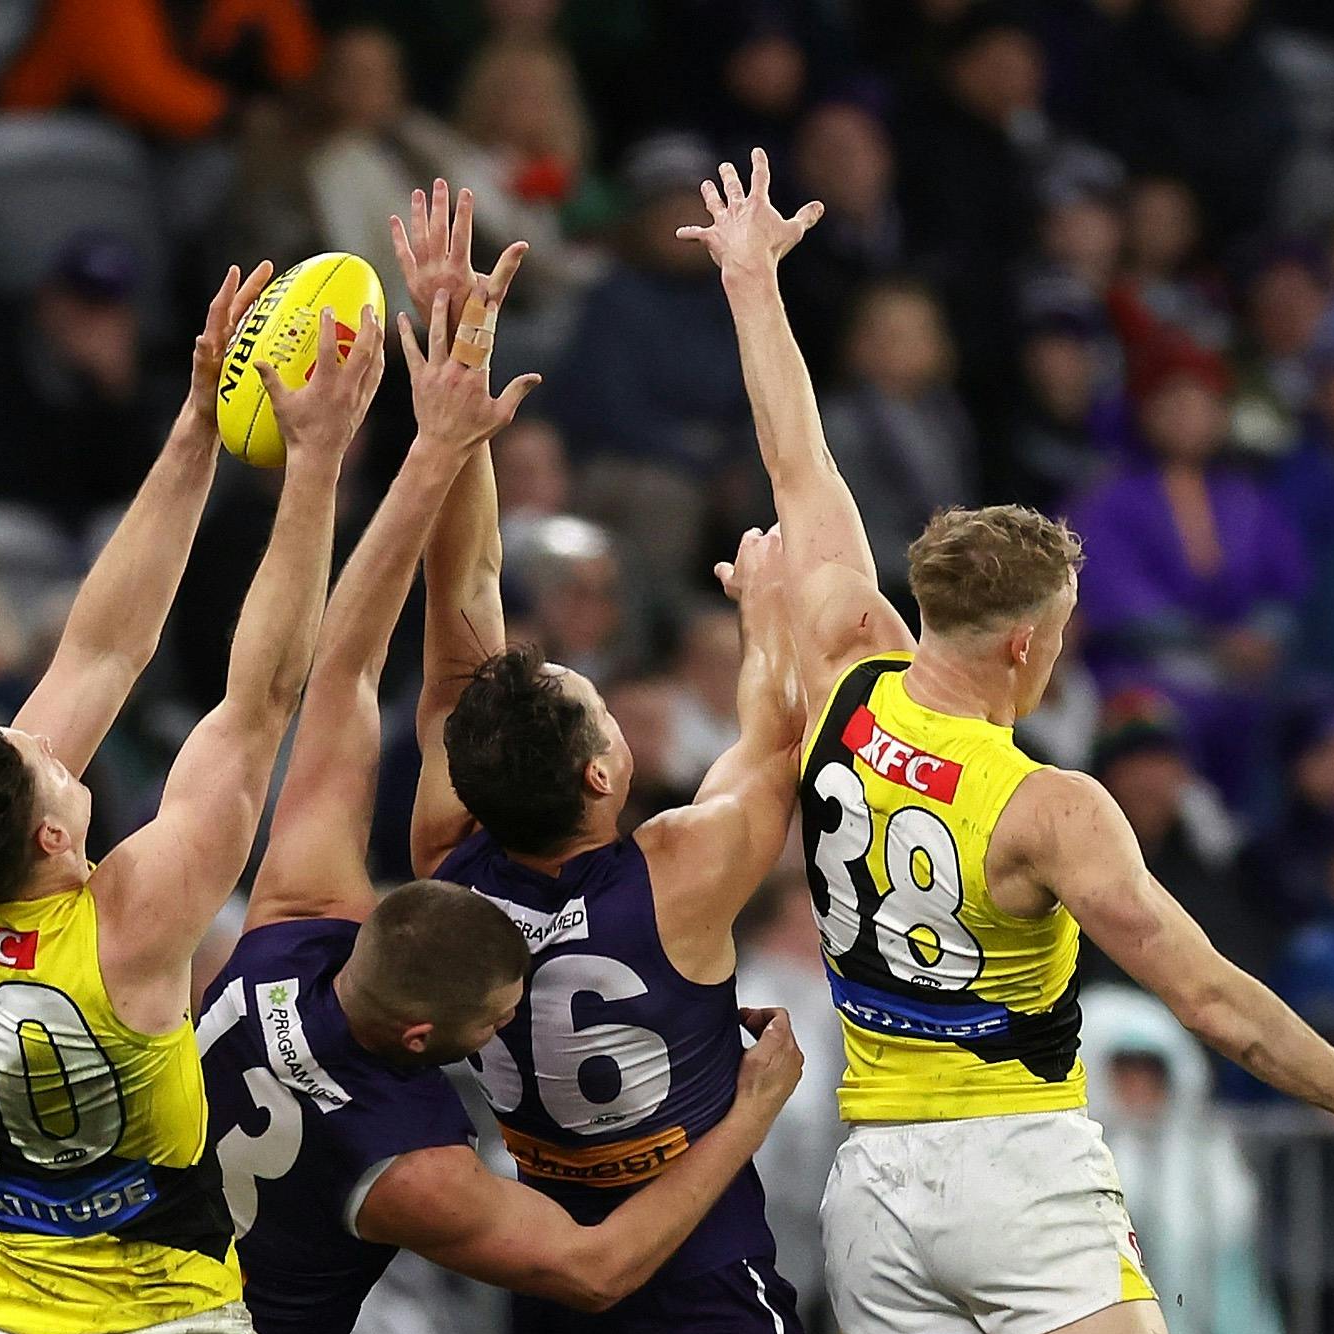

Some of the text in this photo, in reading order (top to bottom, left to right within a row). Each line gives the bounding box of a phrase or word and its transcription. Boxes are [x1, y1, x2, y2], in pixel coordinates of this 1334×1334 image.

[219, 264, 303, 404] SHERRIN
[857, 724, 943, 792] KFC
[814, 761, 985, 991] 38
